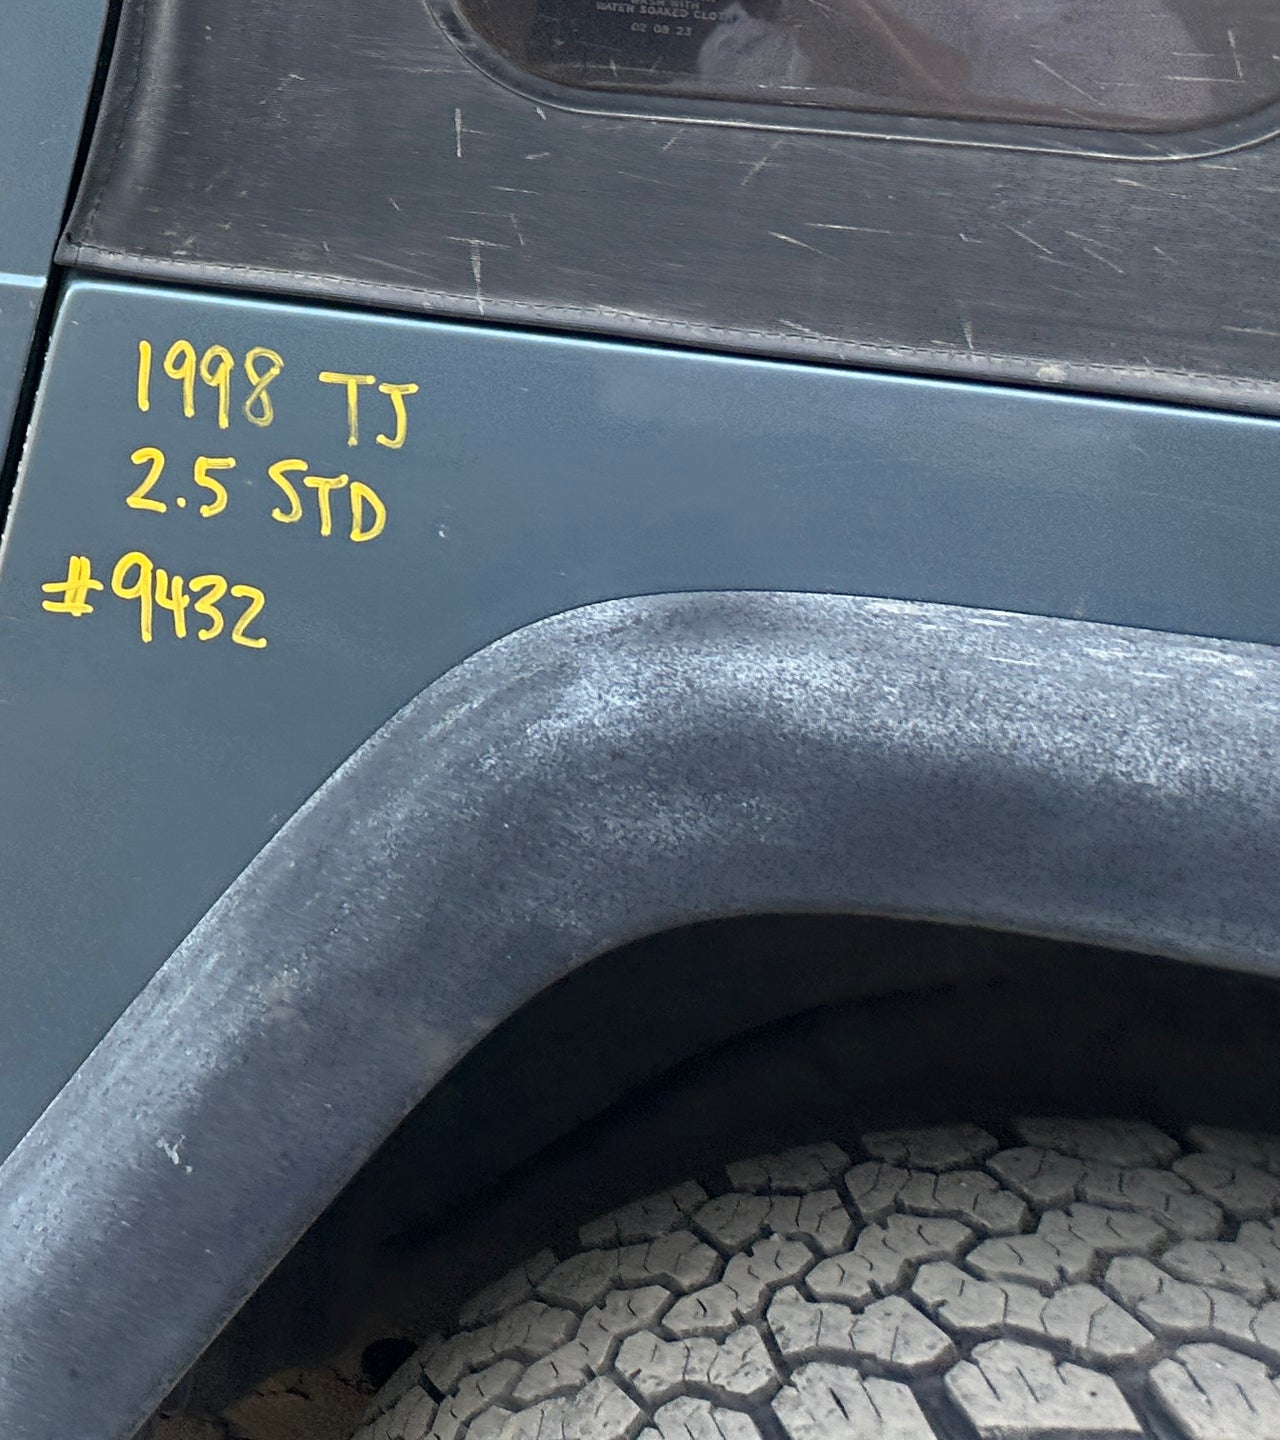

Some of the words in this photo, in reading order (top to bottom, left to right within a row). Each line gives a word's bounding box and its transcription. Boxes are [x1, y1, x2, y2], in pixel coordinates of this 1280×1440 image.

[640, 5, 689, 19] SOAKED
[136, 339, 284, 429] 1998
[318, 371, 420, 450] TJ
[126, 446, 237, 518] 2.5
[267, 458, 388, 542] STD
[41, 550, 268, 649] #9432
